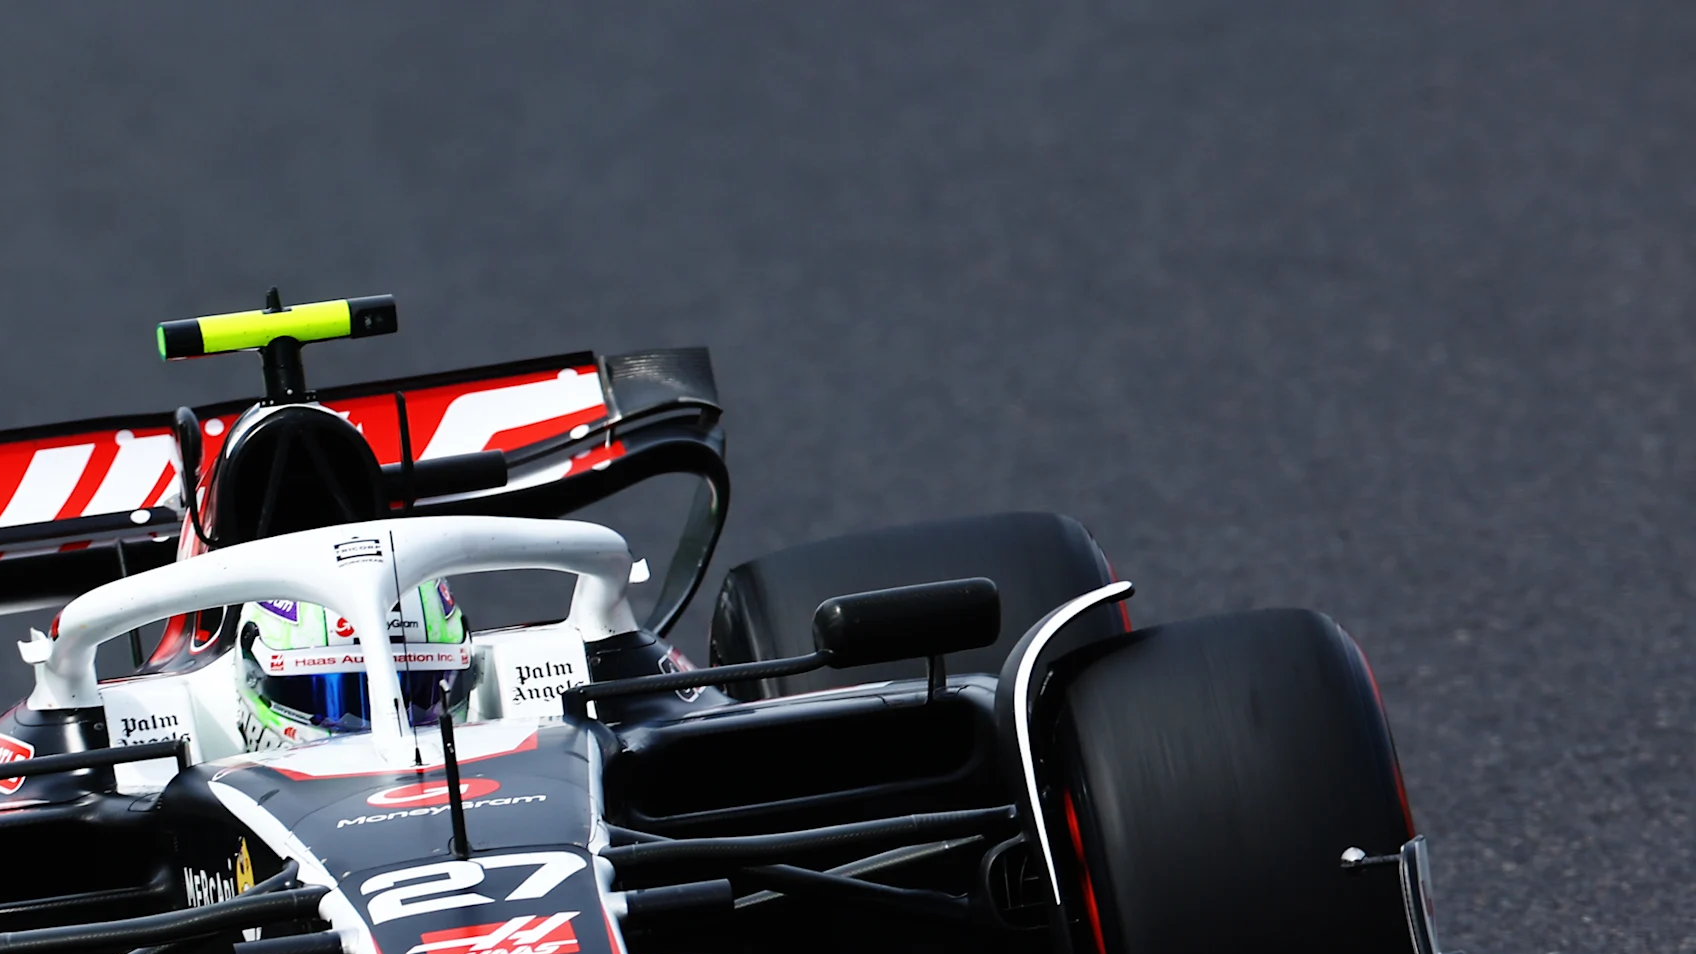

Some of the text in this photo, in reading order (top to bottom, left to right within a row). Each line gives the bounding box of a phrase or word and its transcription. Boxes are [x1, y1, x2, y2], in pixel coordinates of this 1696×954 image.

[295, 656, 337, 667] Haas
[515, 661, 574, 685] Palm
[120, 714, 179, 738] Palm
[359, 851, 588, 926] 27
